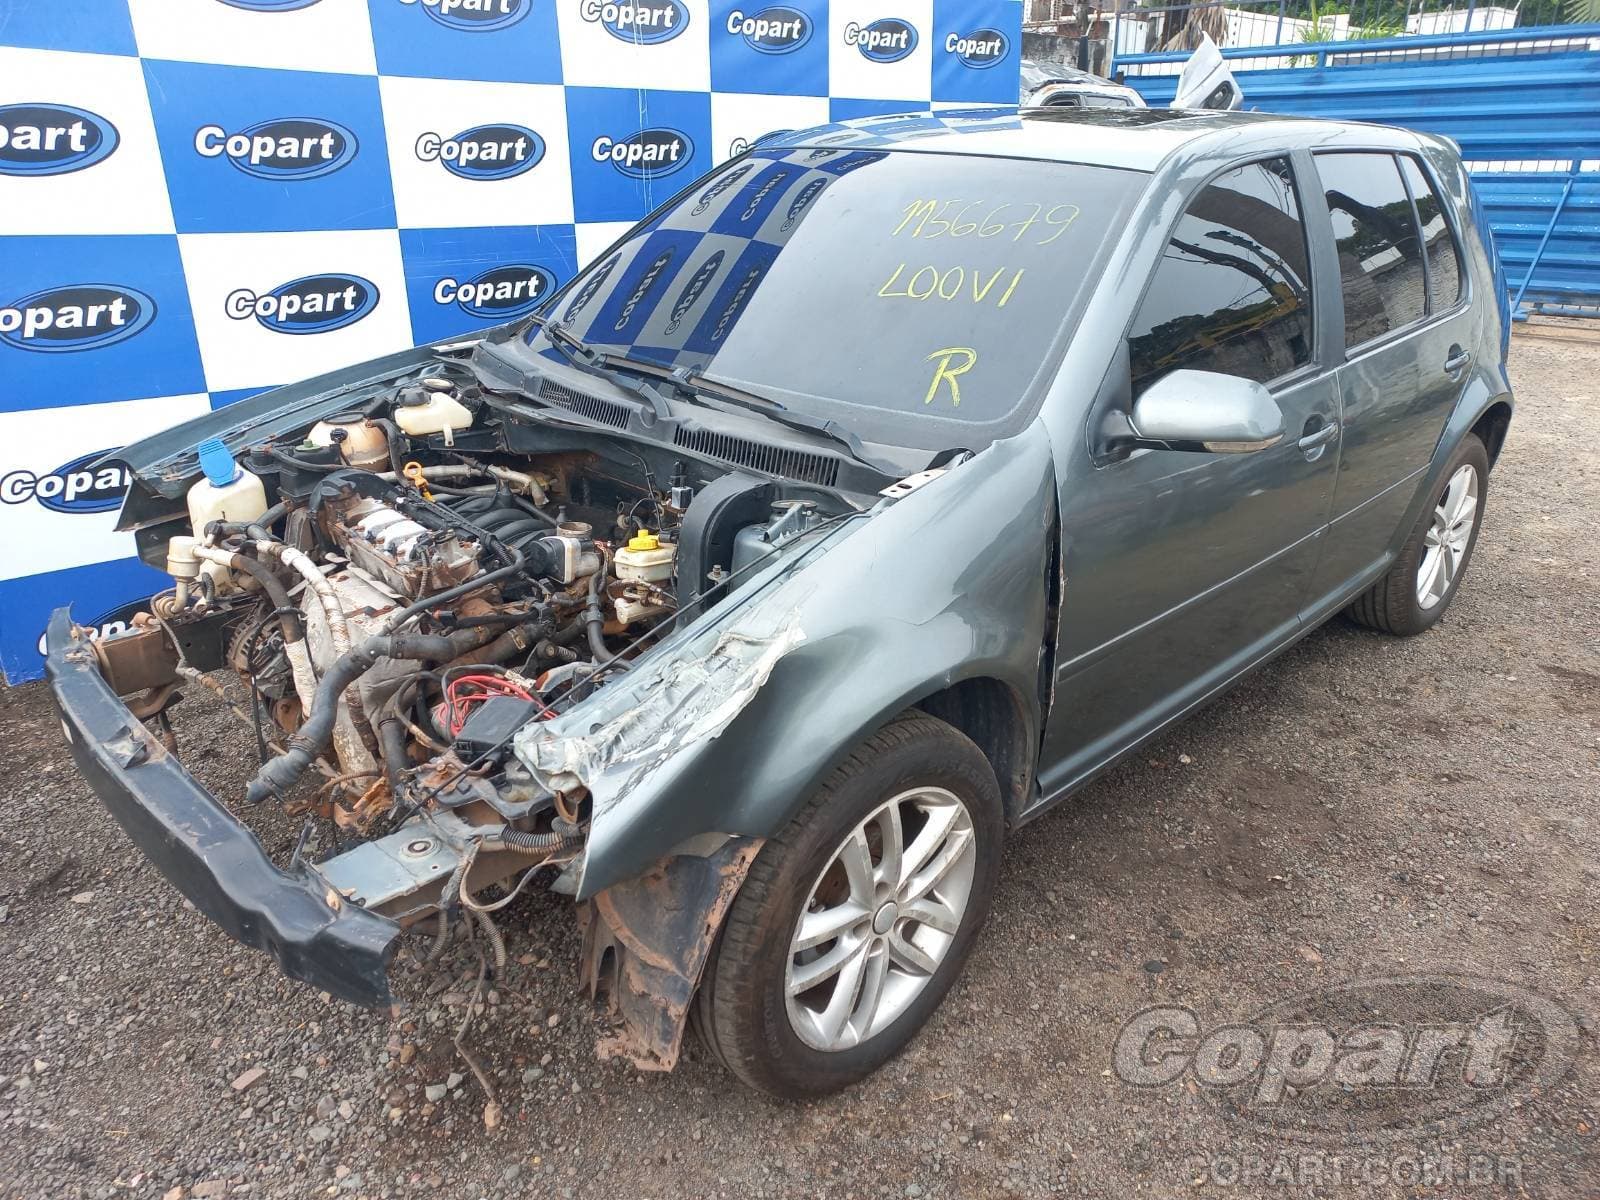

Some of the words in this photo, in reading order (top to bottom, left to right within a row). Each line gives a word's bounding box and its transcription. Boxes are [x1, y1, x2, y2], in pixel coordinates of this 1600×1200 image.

[581, 0, 674, 29] Copart
[727, 11, 801, 41] Copart
[844, 22, 908, 51] Copart
[946, 33, 1001, 58] Copart
[0, 121, 87, 152] art
[194, 125, 335, 164] Copart
[415, 132, 526, 167] Copart
[592, 136, 680, 166] Copart
[225, 285, 357, 322] Copart
[434, 274, 539, 307] Copart
[923, 347, 977, 408] R
[0, 466, 131, 503] Copa
